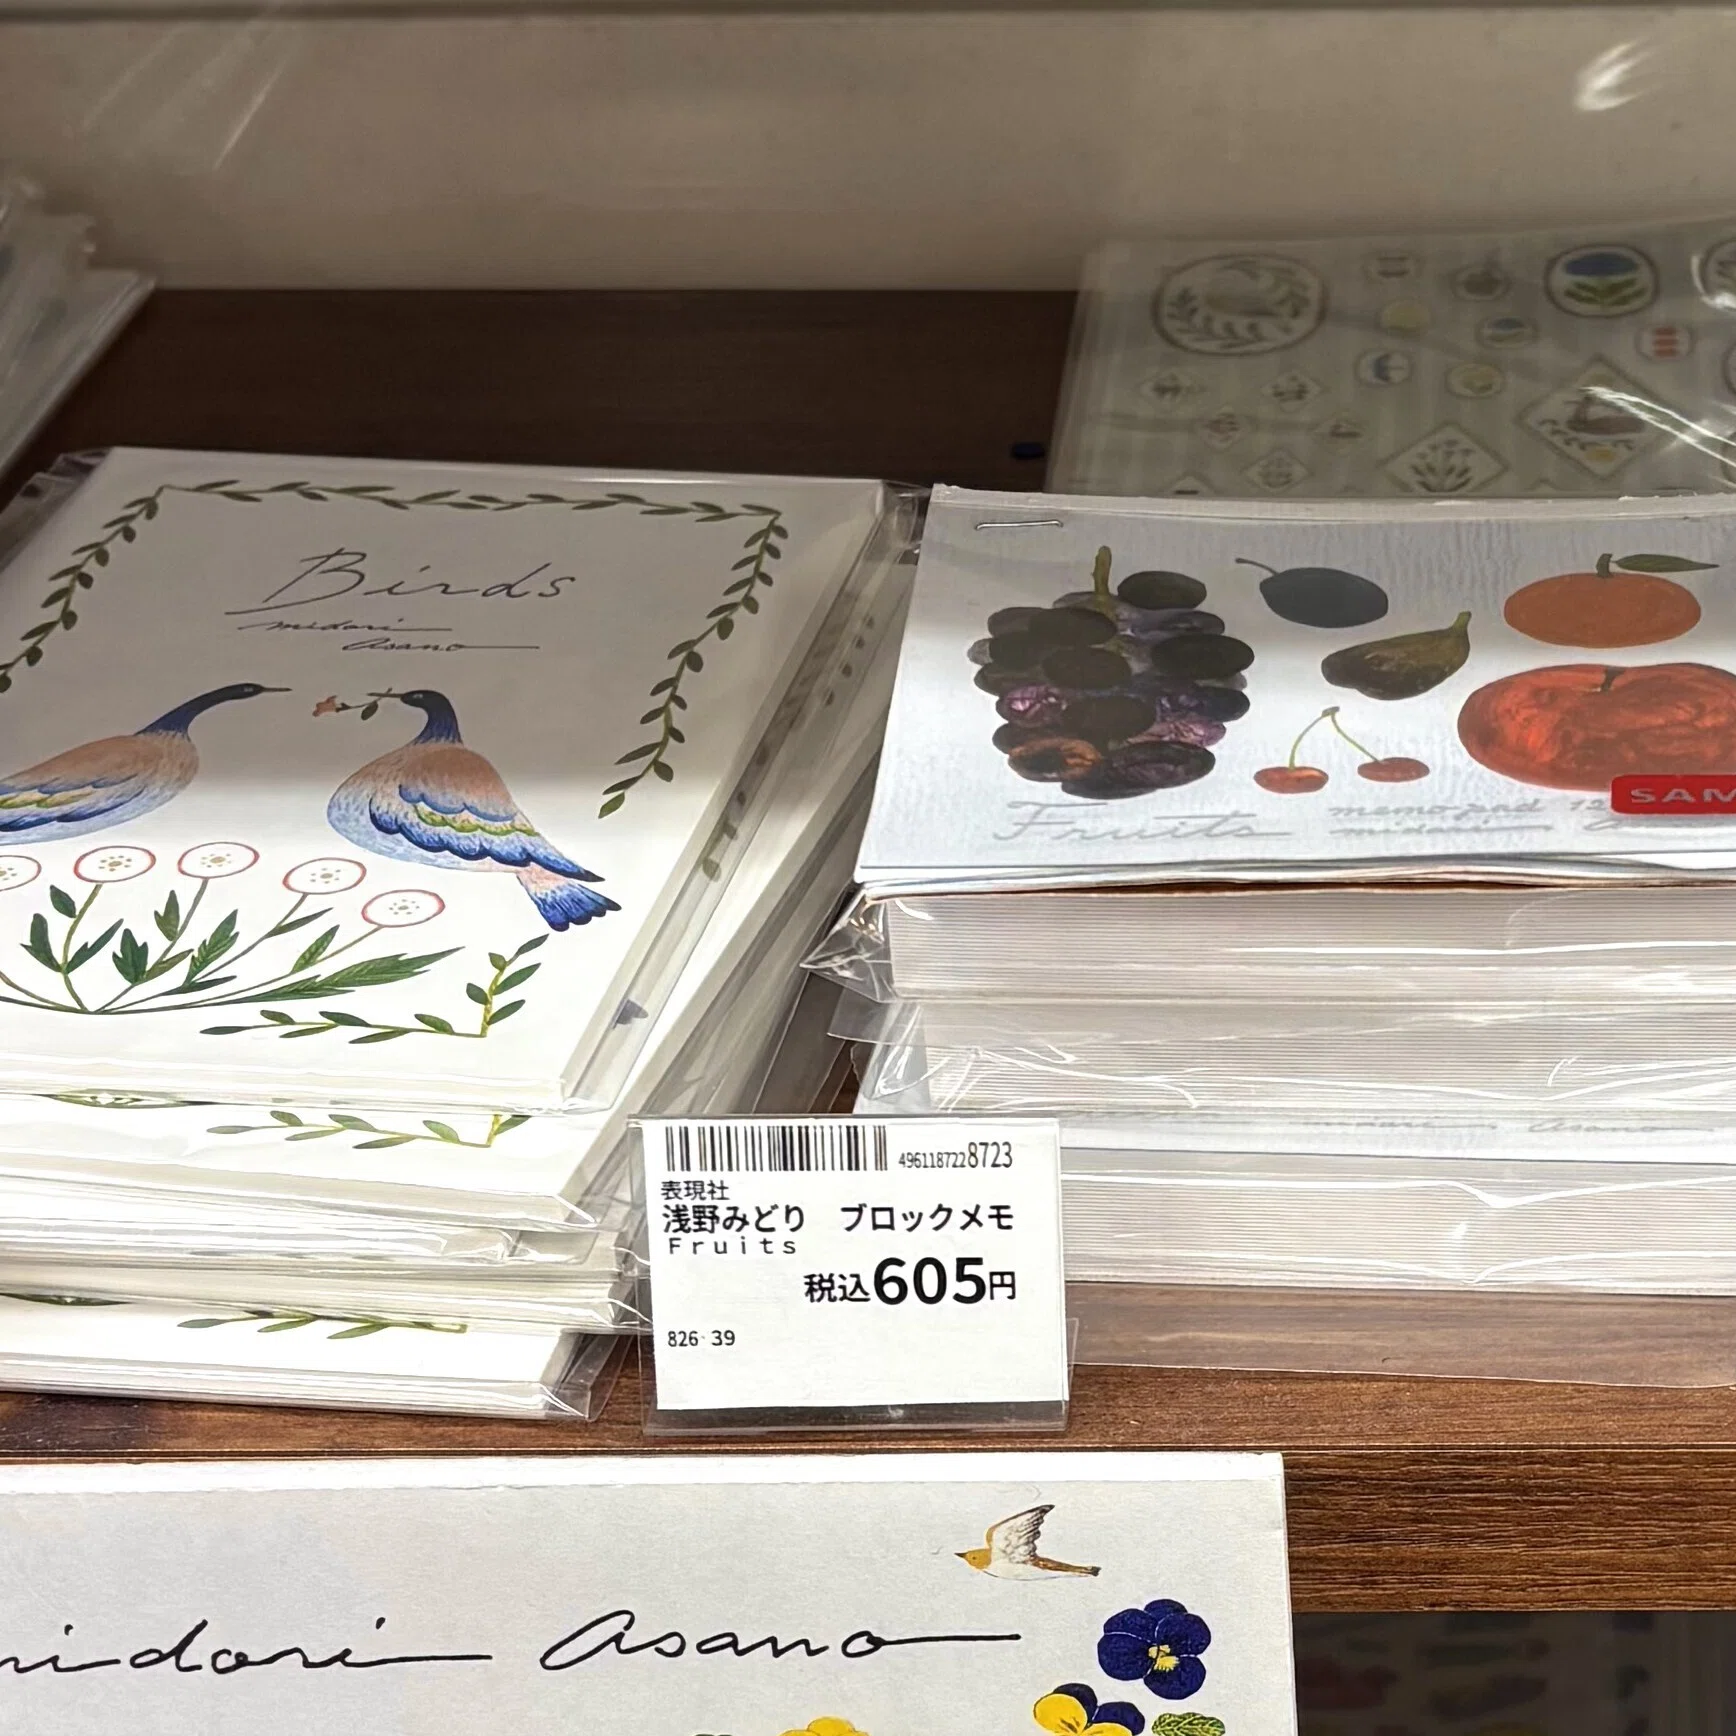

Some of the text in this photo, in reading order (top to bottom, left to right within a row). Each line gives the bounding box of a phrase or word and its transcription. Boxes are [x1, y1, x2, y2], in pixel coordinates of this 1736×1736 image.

[225, 547, 575, 615] Birds
[898, 1141, 1013, 1169] 4961187228723
[660, 1180, 730, 1201] 表現社
[661, 1202, 1014, 1234] 浅野みどり ブロックメモ
[668, 1236, 797, 1256] Fruits
[804, 1256, 1017, 1305] 税込605円
[711, 1329, 736, 1347] 39
